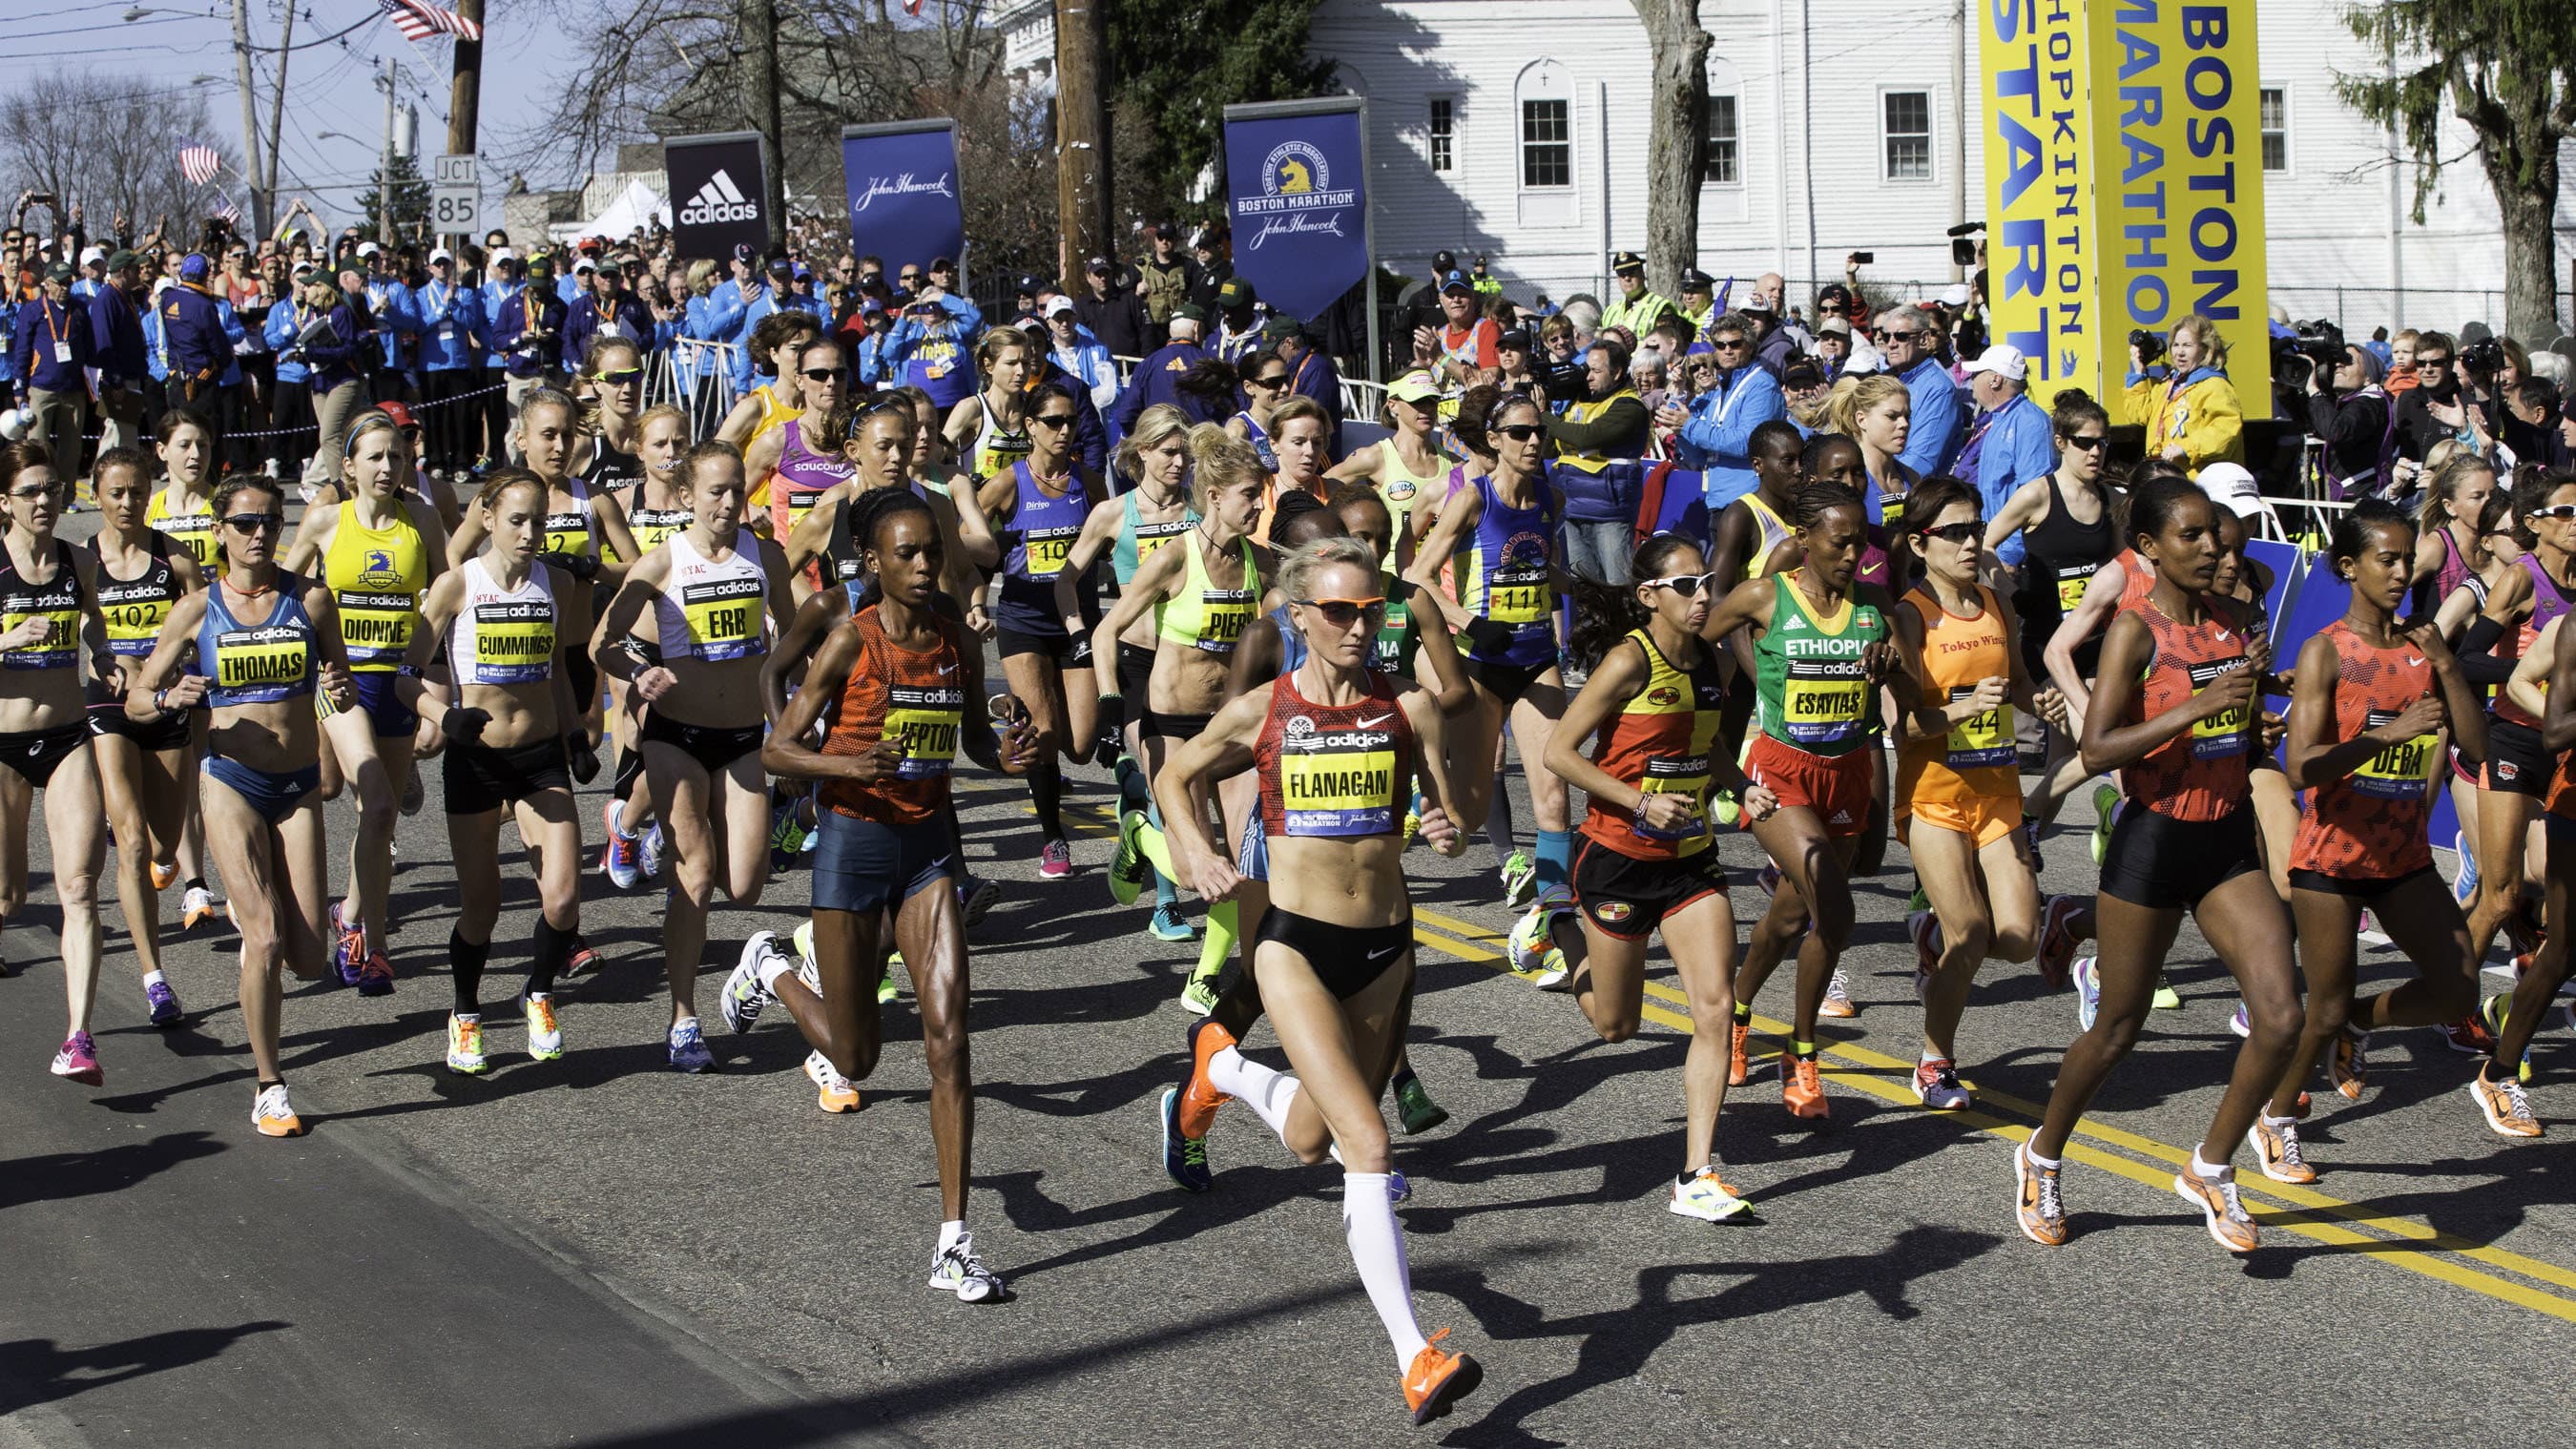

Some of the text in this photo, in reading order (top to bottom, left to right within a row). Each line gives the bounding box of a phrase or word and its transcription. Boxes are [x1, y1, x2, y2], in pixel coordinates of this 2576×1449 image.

[439, 160, 471, 180] JCT
[1270, 143, 1301, 163] ATHLETIC
[1301, 143, 1326, 188] ASSOCIATION
[2046, 0, 2083, 335] HOPKINTON
[2182, 6, 2240, 321] BOSTON
[894, 172, 953, 198] Hancock
[1991, 0, 2049, 381] START
[2115, 0, 2170, 377] ARATHO
[438, 197, 474, 222] 85
[679, 201, 758, 225] adidas
[1237, 193, 1353, 212] BOSTON MARATHON
[1287, 212, 1343, 237] Hancock
[794, 462, 845, 472] saucony
[1025, 501, 1050, 511] Dirigo
[174, 516, 213, 528] adidas
[125, 586, 168, 599] adidas
[717, 580, 760, 595] adidas
[34, 594, 75, 607] adidas
[369, 595, 411, 607] adidas
[509, 604, 551, 617] adidas
[111, 604, 160, 628] 102
[708, 607, 746, 639] ERB
[252, 627, 301, 640] adidas
[344, 618, 406, 644] DIONNE
[479, 635, 553, 656] CUMMINGS
[1940, 640, 1979, 654] Tokyo
[221, 652, 303, 681] THOMAS
[924, 689, 965, 704] adidas
[1795, 692, 1862, 715] ESAYIAS
[1968, 711, 2001, 735] 44
[1326, 733, 1389, 748] adidas
[2372, 743, 2424, 776] DEBA
[1291, 770, 1388, 798] FLANAGAN
